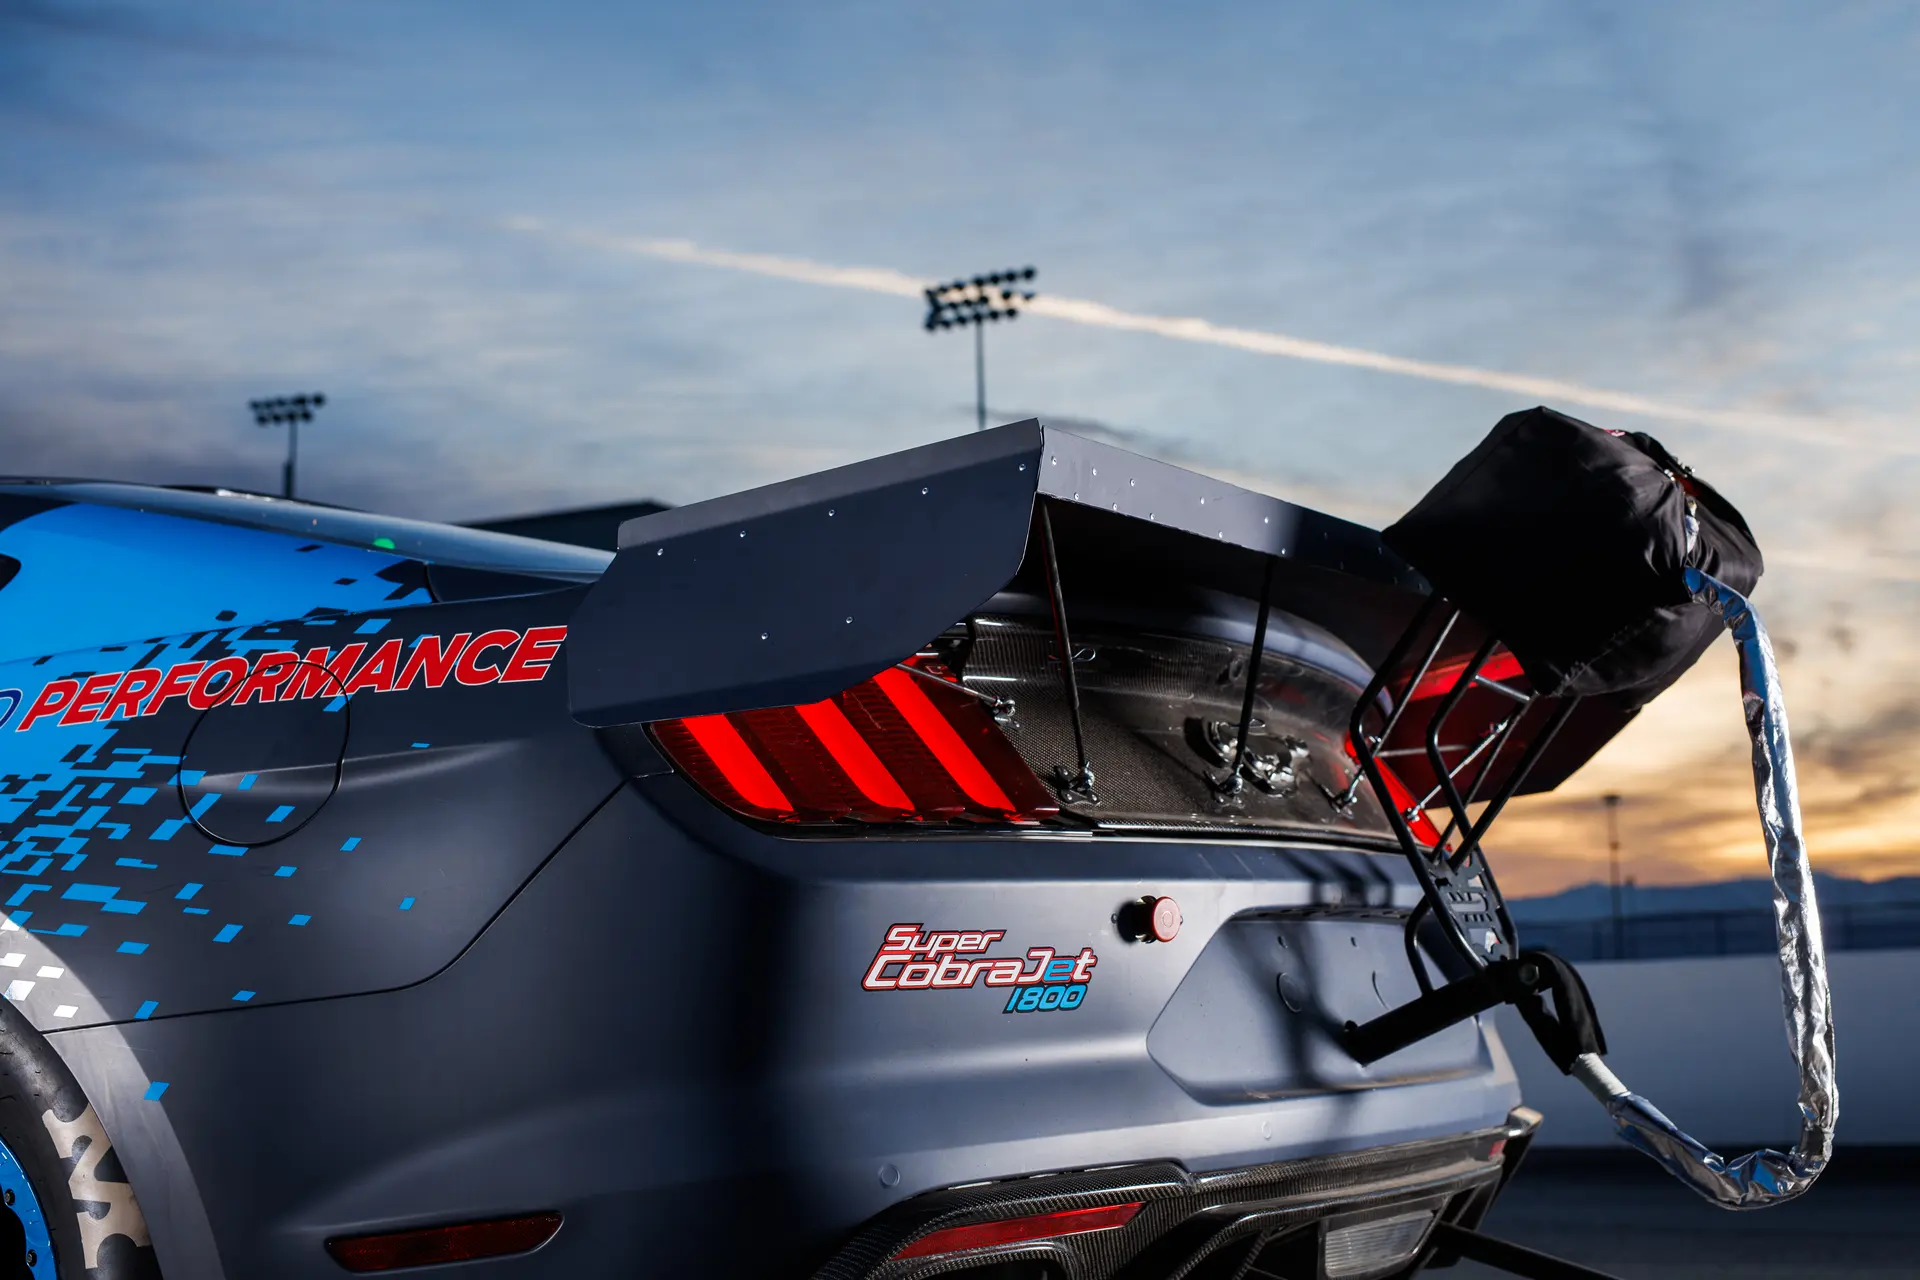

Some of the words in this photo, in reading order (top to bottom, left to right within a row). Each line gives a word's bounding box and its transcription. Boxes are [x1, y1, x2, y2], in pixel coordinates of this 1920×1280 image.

[15, 624, 568, 733] PERFORMANCE
[883, 923, 1006, 958] Super
[1003, 984, 1088, 1013] 1800
